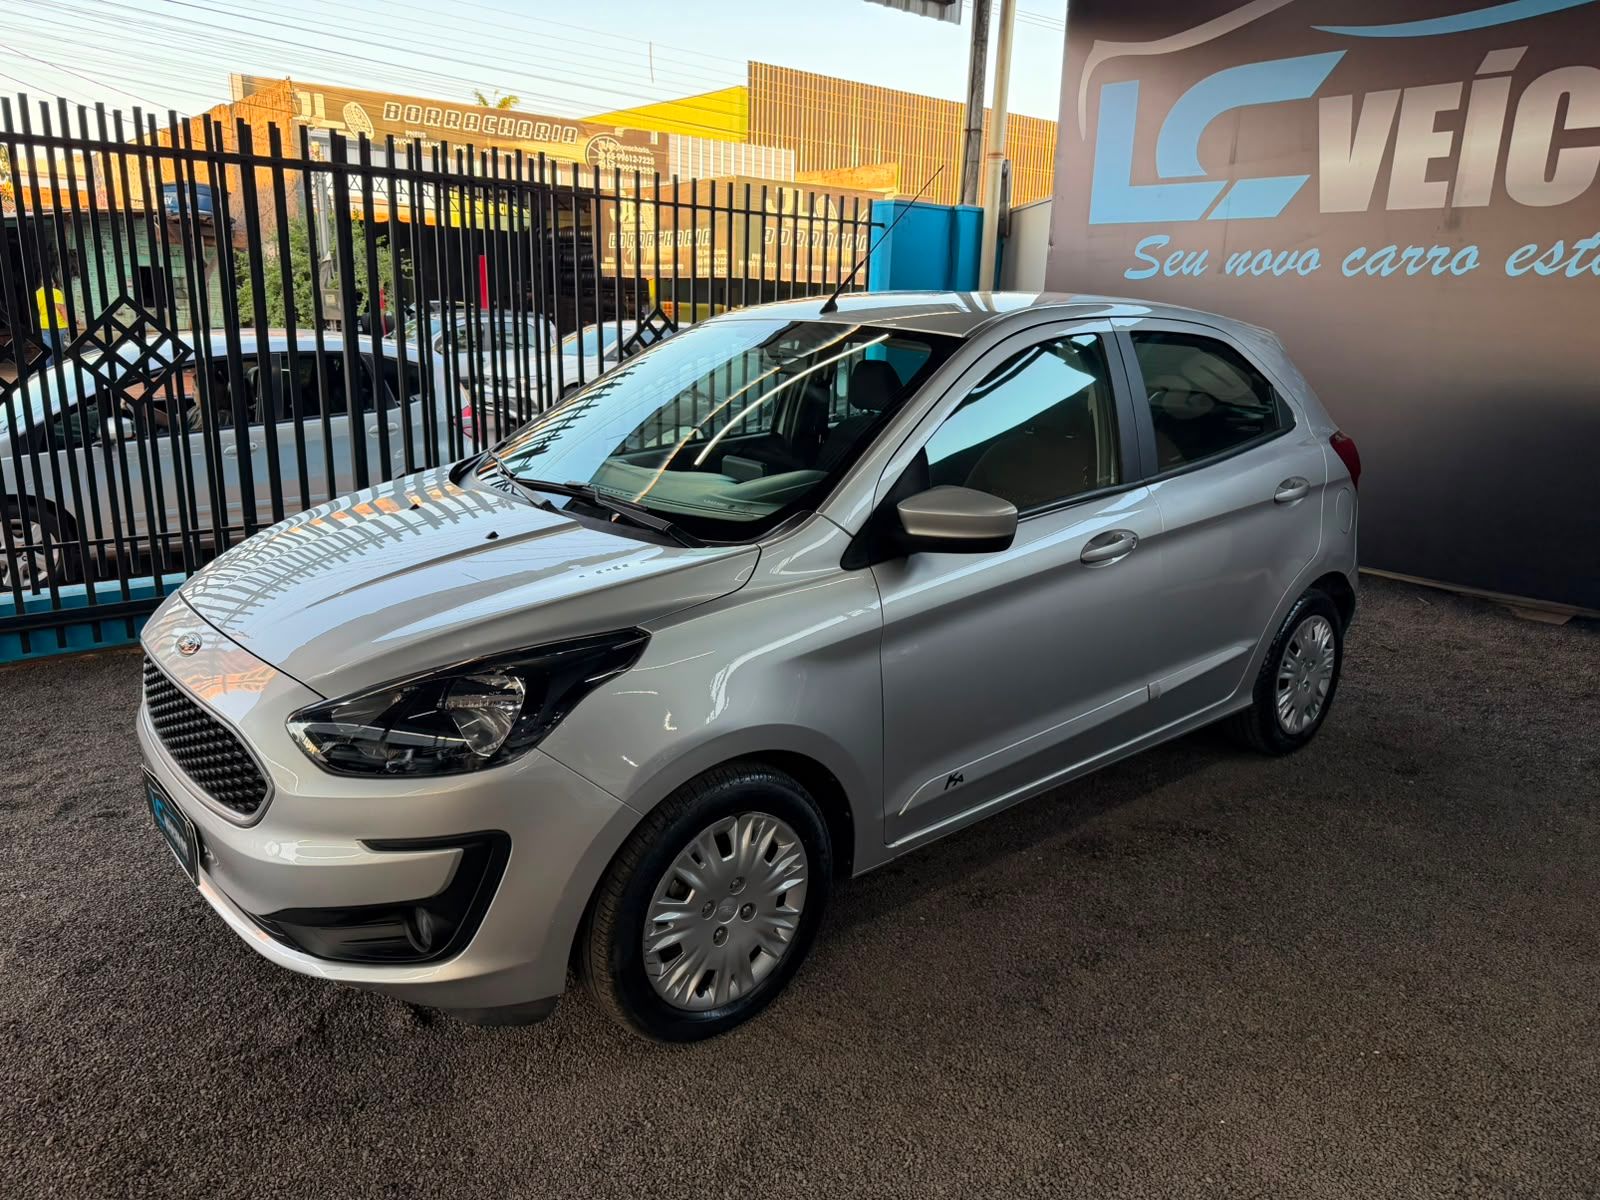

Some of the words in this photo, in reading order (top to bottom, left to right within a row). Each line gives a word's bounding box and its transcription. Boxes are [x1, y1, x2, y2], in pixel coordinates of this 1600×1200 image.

[383, 101, 578, 145] BORRACHARIA
[1123, 234, 1209, 280] Seu
[1225, 247, 1322, 277] novo
[1341, 244, 1480, 277] carro
